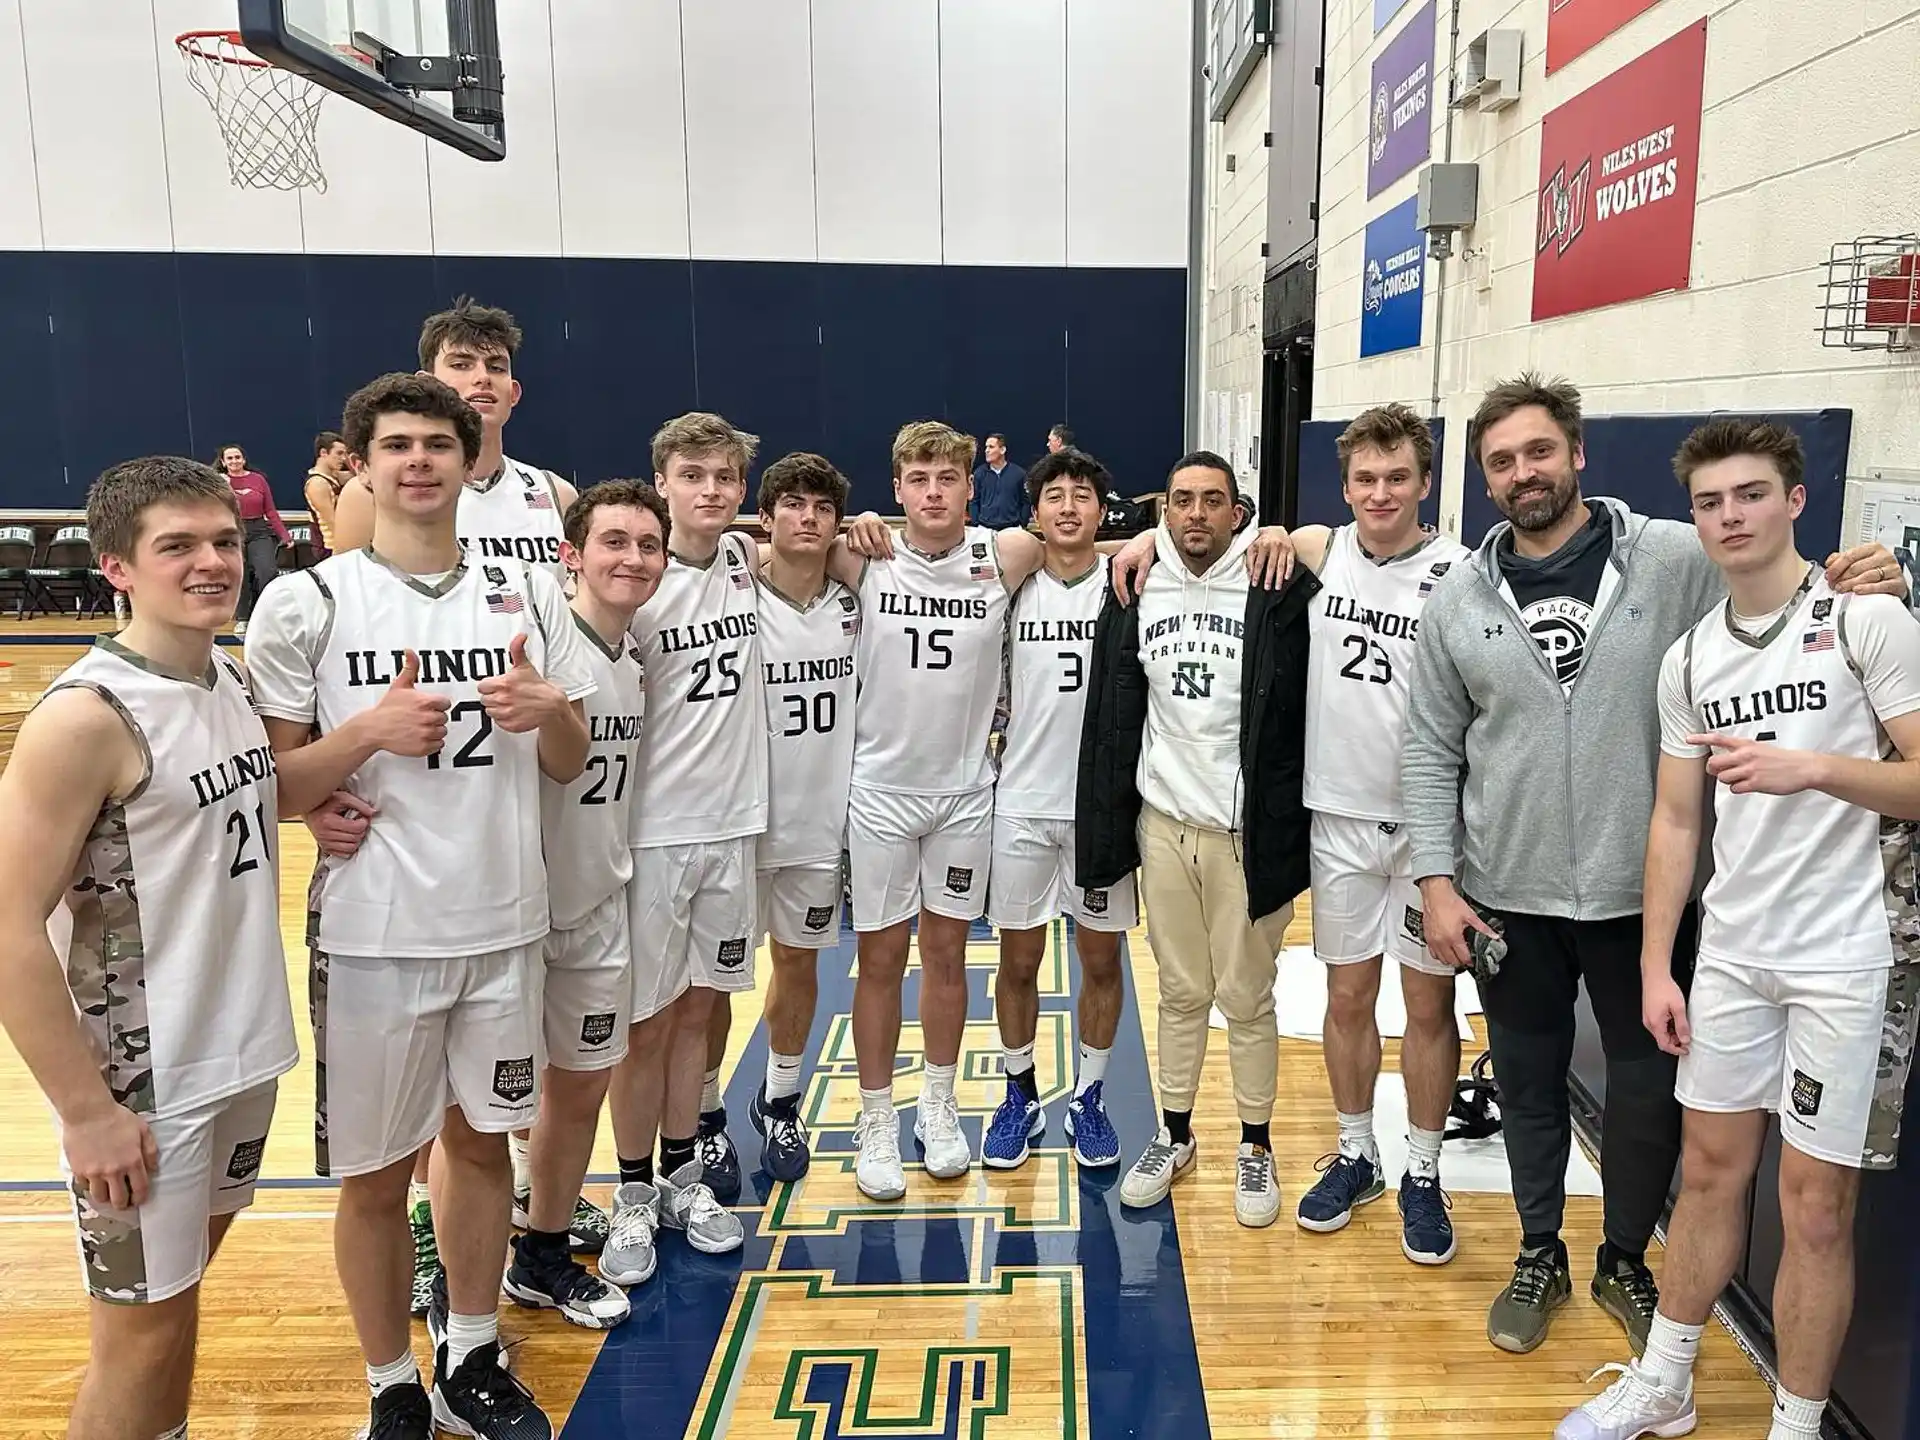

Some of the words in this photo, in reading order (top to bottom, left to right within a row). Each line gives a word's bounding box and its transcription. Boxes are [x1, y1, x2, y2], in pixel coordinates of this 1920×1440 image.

[1393, 84, 1427, 132] VIKINGS
[1602, 143, 1636, 177] NILES
[1638, 124, 1675, 161] WEST
[1596, 157, 1677, 222] WOLVES
[1384, 266, 1421, 300] COUGARS
[879, 592, 987, 619] ILLINOIS
[1537, 602, 1590, 628] PACKA
[658, 612, 758, 654] ILLINOIS
[904, 627, 953, 670] 15
[1145, 613, 1186, 645] NEW
[687, 650, 741, 703] 25
[1057, 652, 1083, 693] 3
[1340, 634, 1391, 686] 23
[783, 690, 836, 737] 30
[1703, 680, 1827, 730] ILLINOIS
[580, 754, 628, 805] 27
[497, 1079, 533, 1090] GUARD
[500, 1066, 532, 1076] ARMY
[1796, 1080, 1817, 1095] RMY
